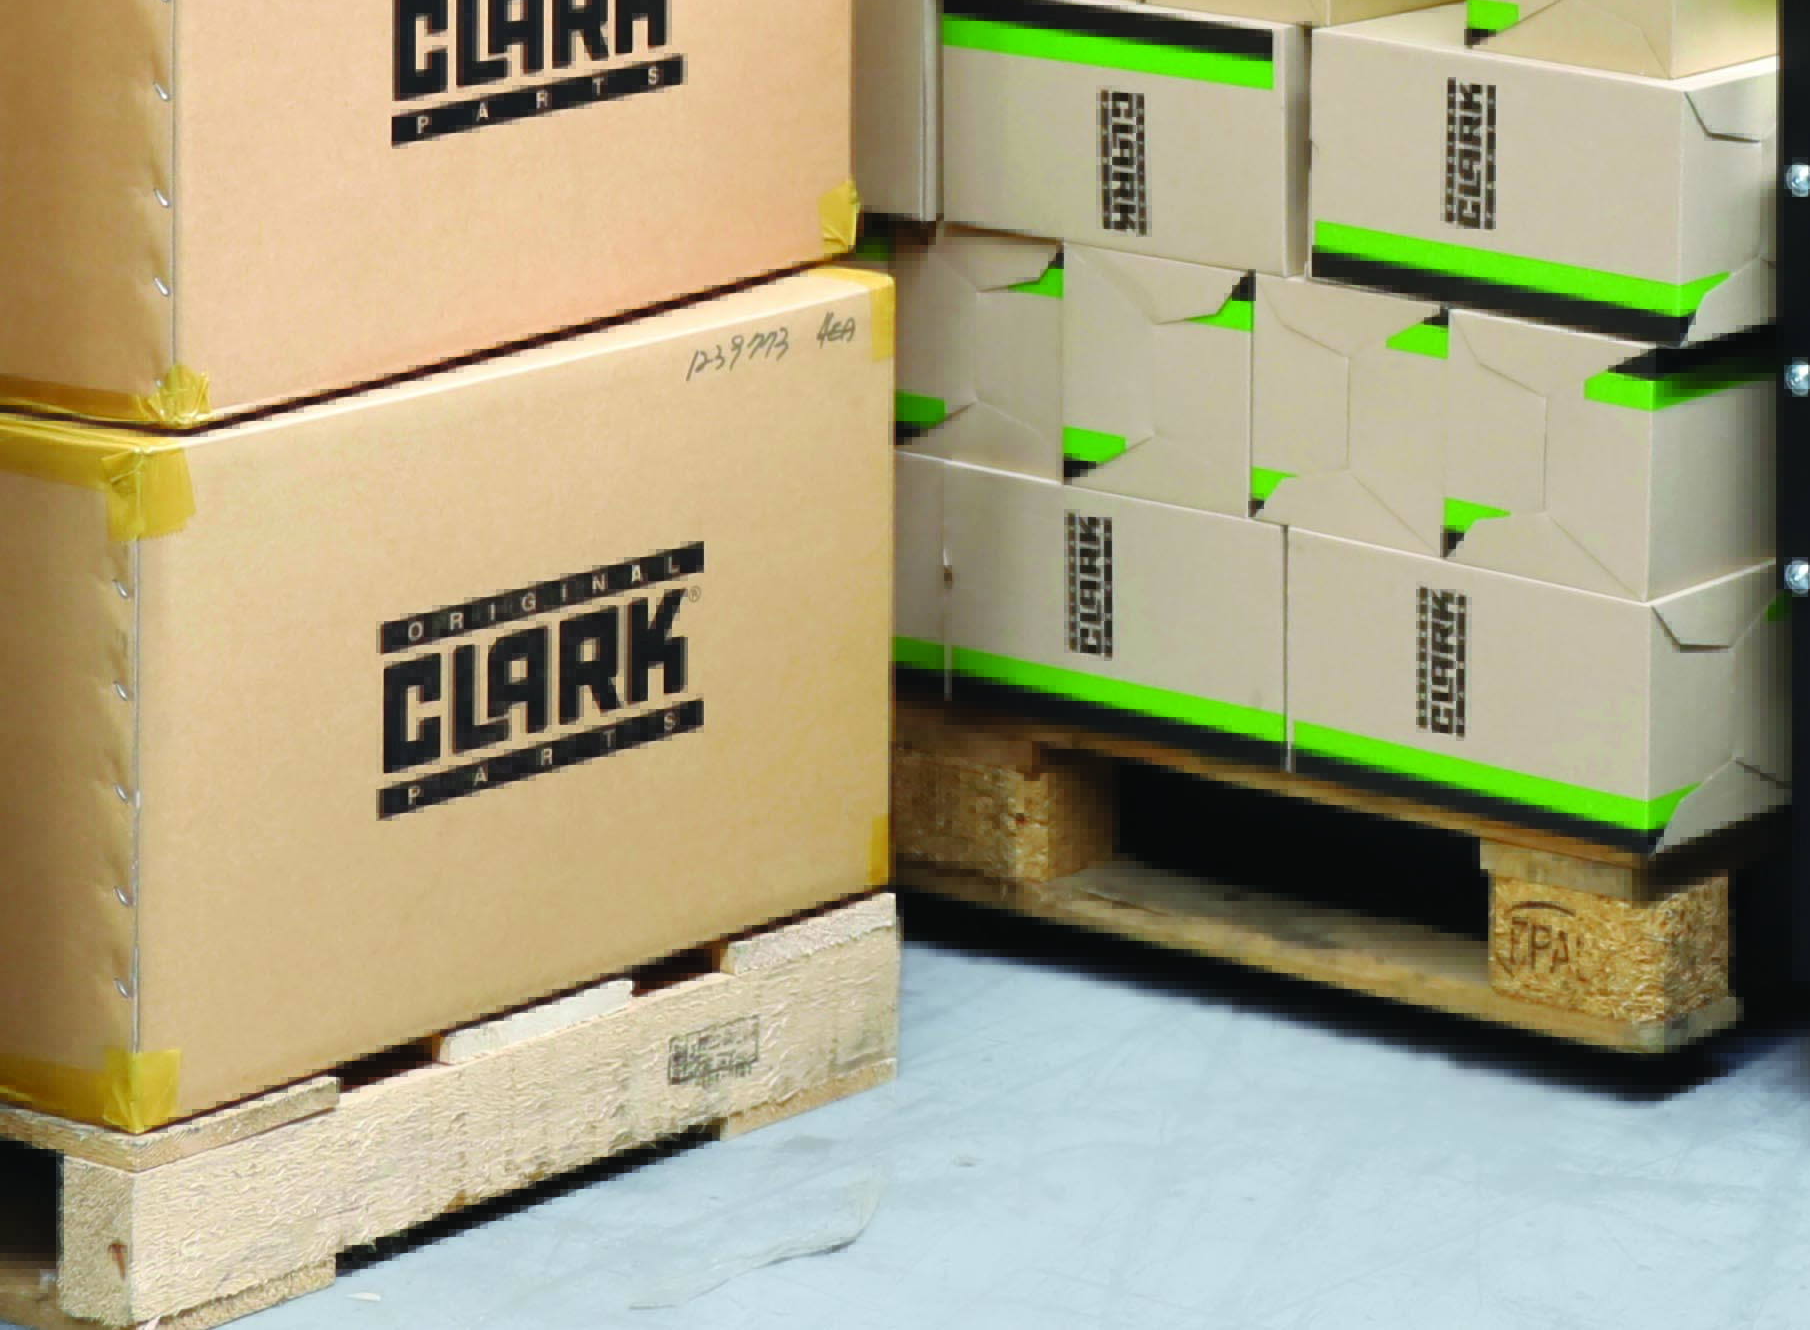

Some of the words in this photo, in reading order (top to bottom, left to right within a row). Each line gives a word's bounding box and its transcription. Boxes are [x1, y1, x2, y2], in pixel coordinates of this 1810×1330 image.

[415, 66, 661, 135] PARTS
[1111, 90, 1138, 233] CLARK
[1458, 82, 1483, 230] CLARK
[407, 555, 680, 642] ORIGINAL
[1079, 516, 1103, 657] CLARK
[383, 587, 690, 774] CLARK
[1431, 588, 1456, 735] CLARK
[407, 711, 678, 805] PARTS
